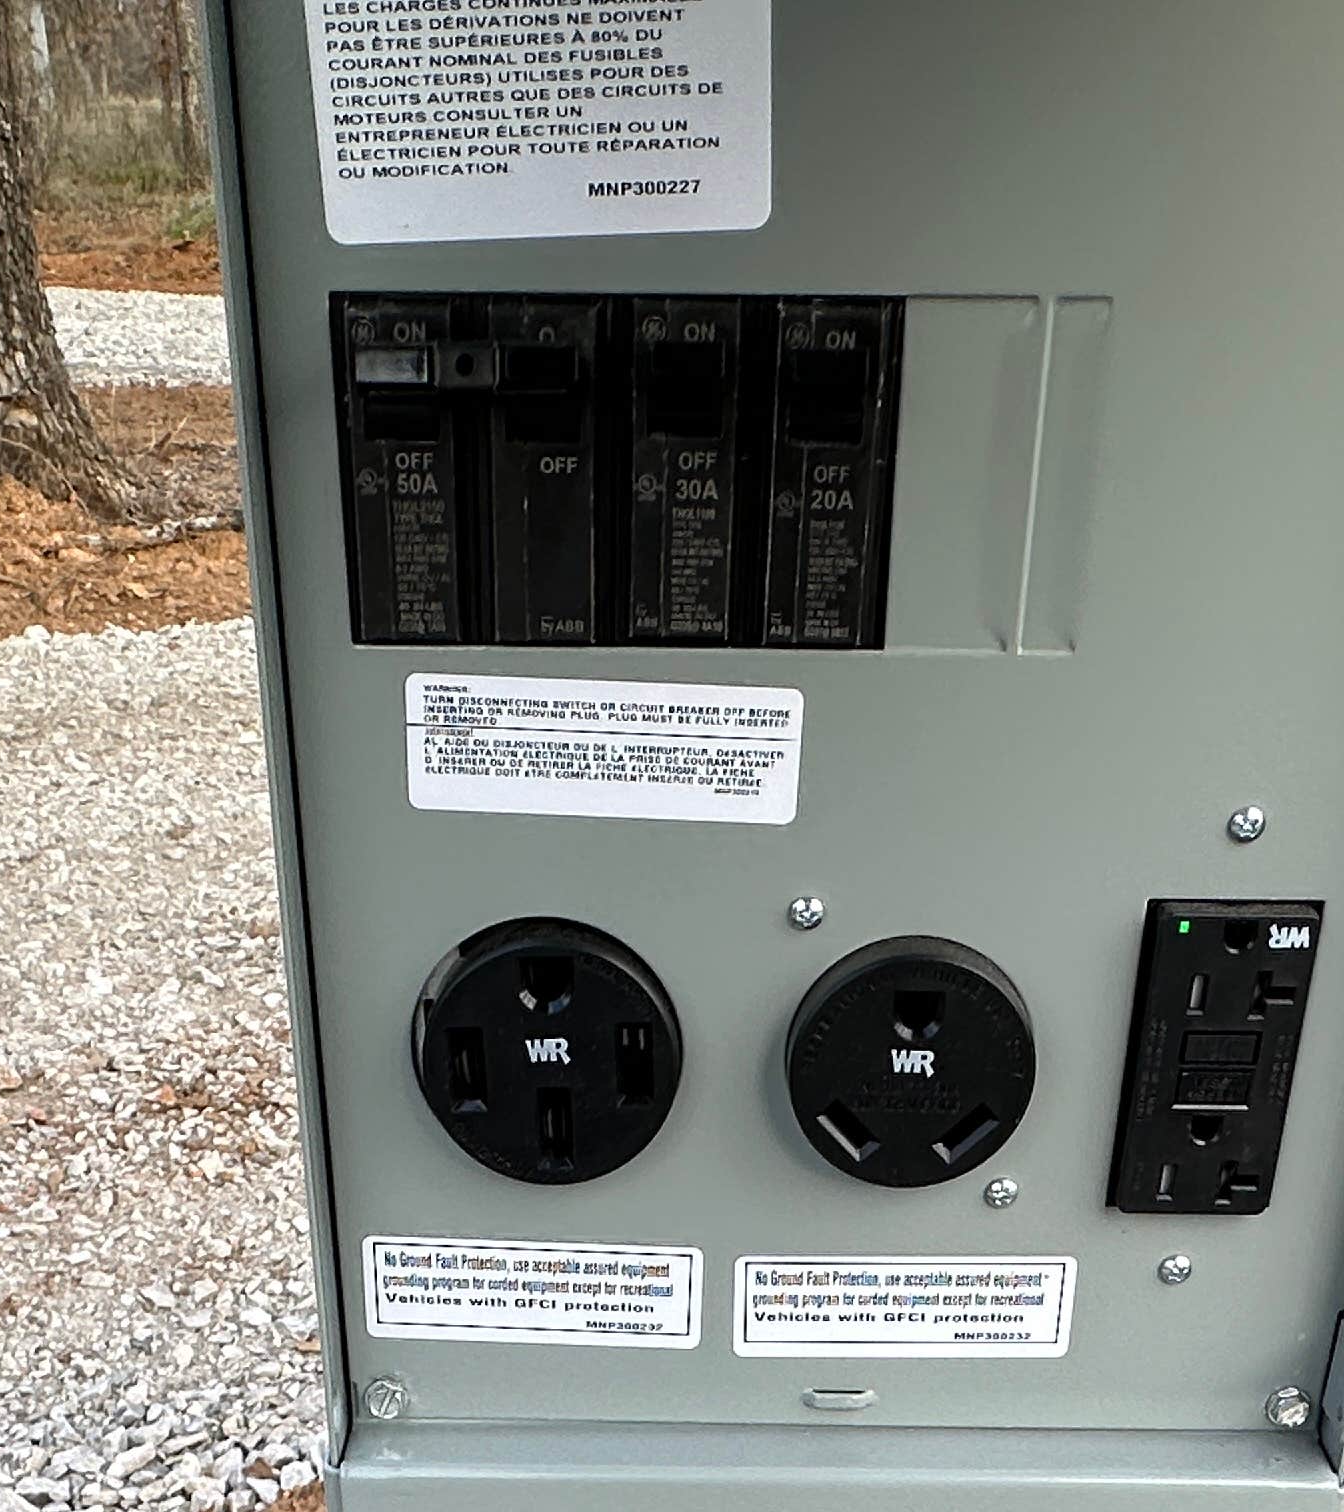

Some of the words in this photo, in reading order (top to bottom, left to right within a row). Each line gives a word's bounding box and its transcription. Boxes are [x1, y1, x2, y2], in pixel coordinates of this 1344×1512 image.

[323, 2, 359, 15] LES
[366, 0, 461, 13] CHARGES
[324, 20, 379, 33] POUR
[386, 18, 422, 31] LES
[429, 13, 560, 30] DÉRIVATIONS
[566, 12, 592, 24] NE
[598, 8, 685, 24] DOIVENT
[326, 40, 365, 52] PAS
[372, 35, 421, 51] ÊTRE
[428, 32, 565, 49] SUPÉRIEURES
[571, 28, 585, 43] À
[591, 30, 628, 43] 80%
[635, 28, 662, 41] DU
[328, 56, 422, 71] COURANT
[429, 52, 517, 67] NOMINAL
[524, 50, 562, 64] DES
[568, 46, 663, 62] FUSIBLES
[330, 72, 491, 91] (DISJONCTEURS)
[590, 66, 644, 79] POUR
[650, 64, 689, 77] DES
[332, 93, 421, 107] CIRCUITS
[427, 90, 504, 104] AUTRES
[510, 88, 550, 101] QUE
[557, 87, 595, 99] DES
[602, 83, 691, 98] CIRCUITS
[698, 82, 722, 94] DE
[334, 111, 426, 125] MOTEURS
[433, 106, 549, 122] CONSULTER
[556, 106, 582, 117] UN
[336, 126, 489, 143] ENTREPRENEUR
[496, 121, 621, 137] ÉLECTRICIEN
[627, 121, 655, 133] OU
[662, 120, 687, 132] UN
[337, 146, 461, 161] ÉLECTRICIEN
[468, 143, 520, 156] POUR
[528, 140, 589, 154] TOUTE
[596, 136, 719, 152] RÉPARATION
[338, 167, 365, 179] OU
[372, 162, 508, 177] MODIFICATION
[588, 179, 700, 197] MNP300227
[393, 321, 426, 343] ON
[684, 322, 716, 343] ON
[825, 330, 856, 350] ON
[395, 452, 433, 470] OFF
[540, 456, 578, 474] OFF
[678, 452, 717, 470] OFF
[396, 474, 438, 494] 50A
[813, 466, 851, 484] OFF
[676, 479, 718, 500] 30A
[810, 490, 854, 511] 20A
[1269, 923, 1310, 949] WR
[525, 1037, 570, 1065] WR
[891, 1048, 935, 1078] WR
